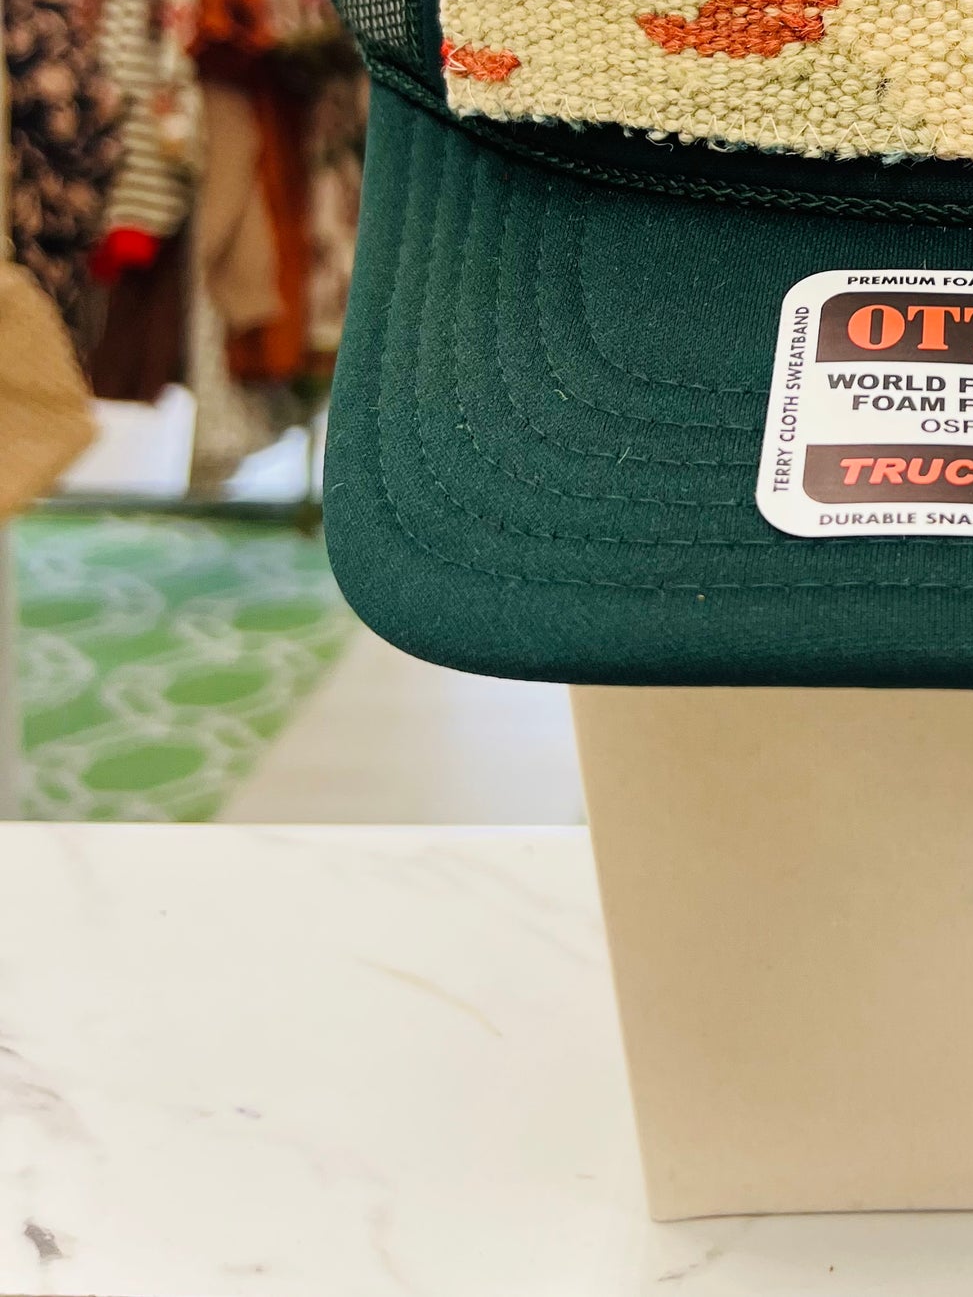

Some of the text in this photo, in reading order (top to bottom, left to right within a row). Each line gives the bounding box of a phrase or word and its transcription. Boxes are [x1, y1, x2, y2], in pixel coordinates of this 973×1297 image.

[847, 276, 936, 286] PREMIUM
[827, 373, 947, 392] WORLD
[773, 306, 810, 492] TERRY CLOTH SWEATBAND
[851, 394, 946, 412] FOAM
[818, 512, 917, 526] DURABLE
